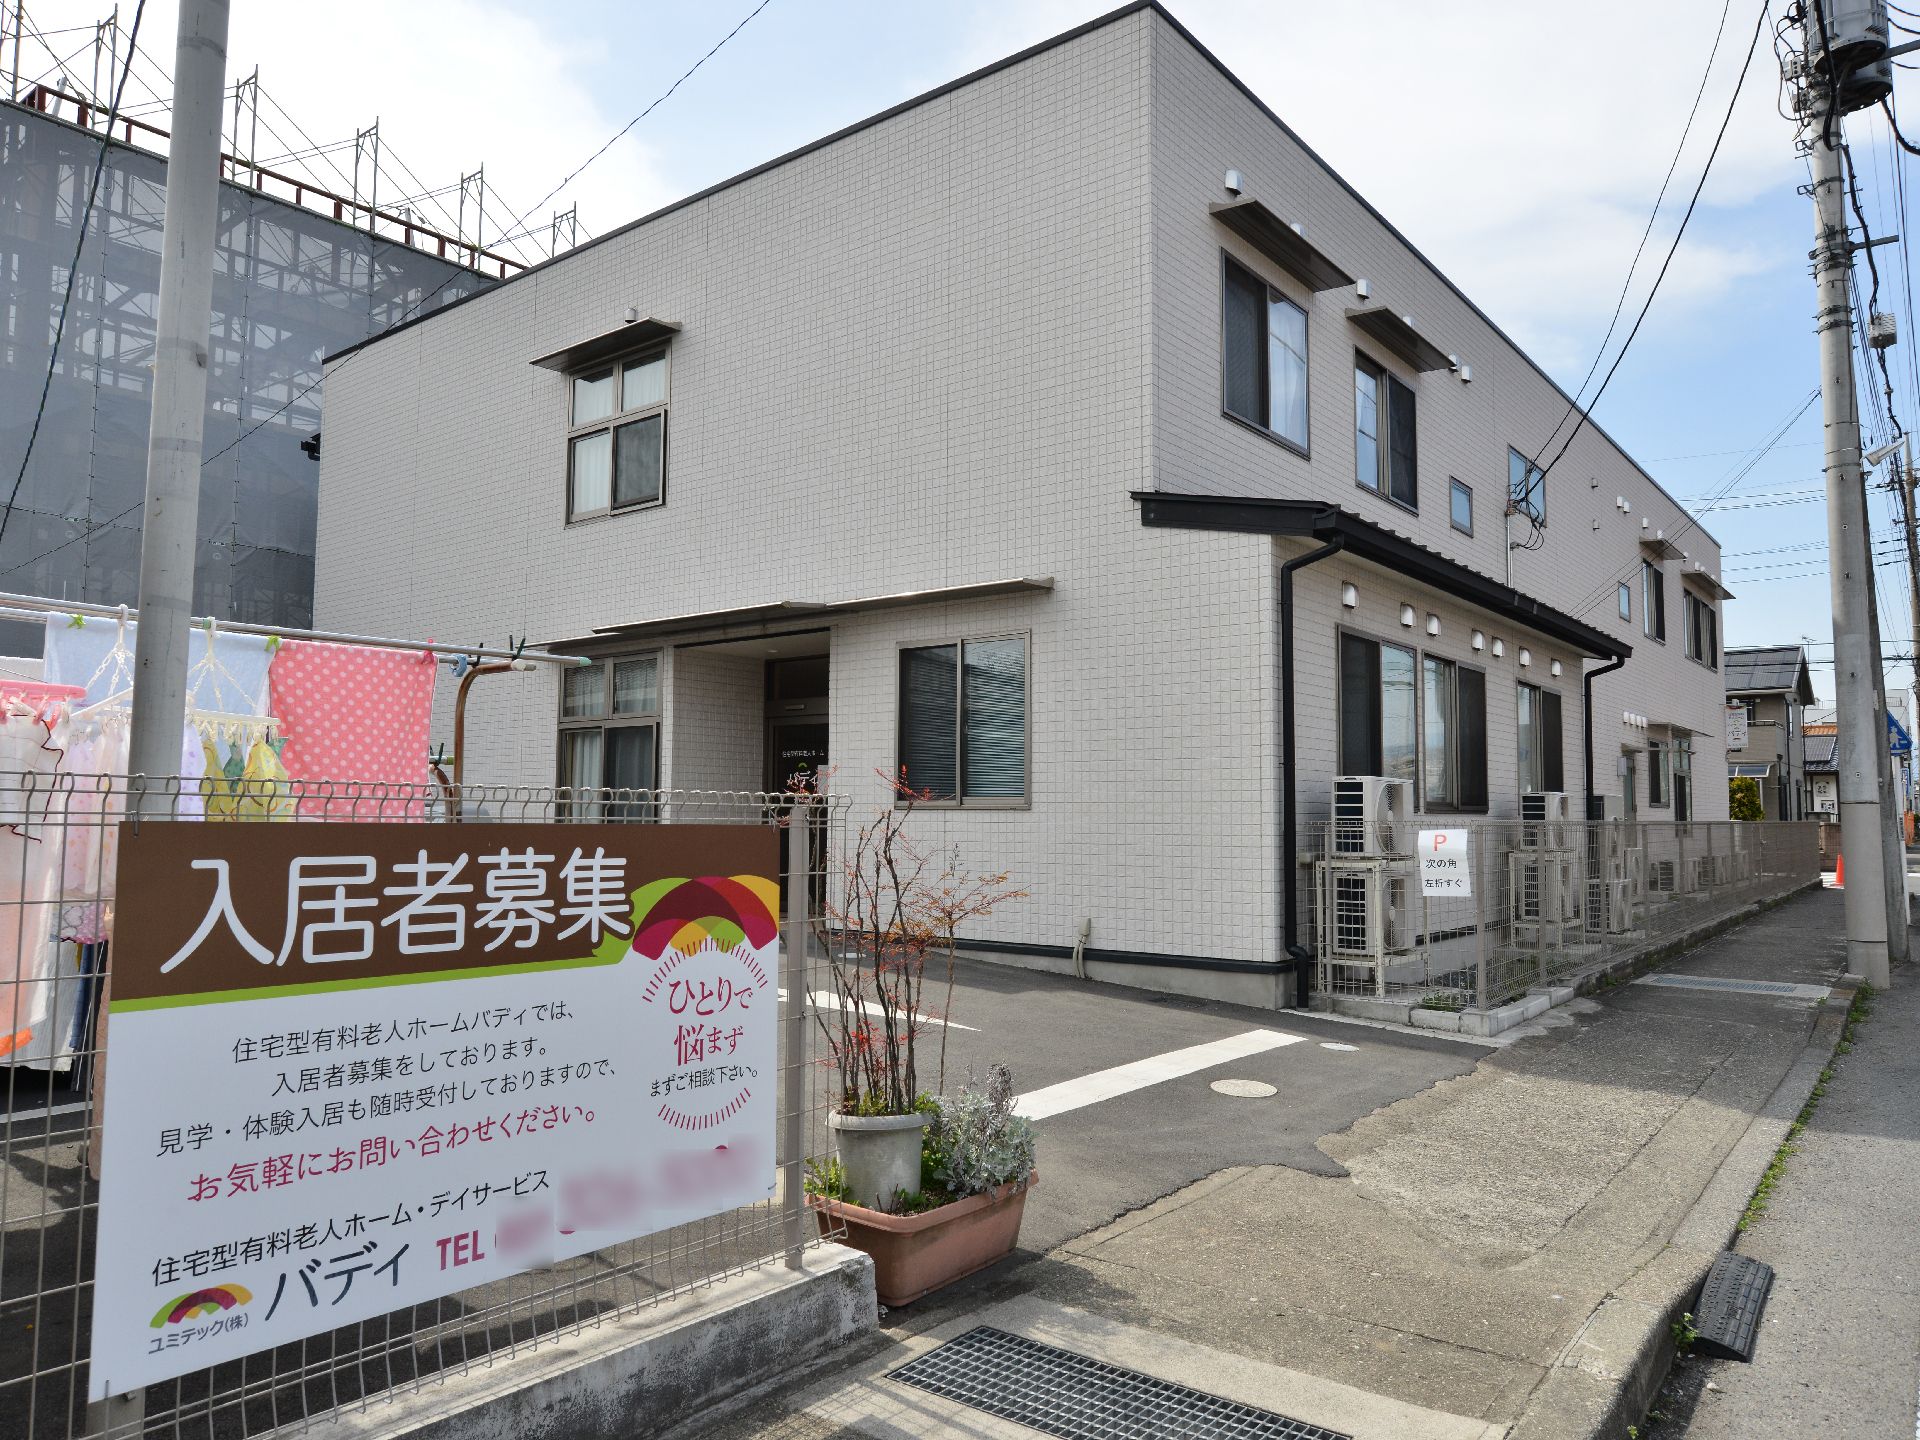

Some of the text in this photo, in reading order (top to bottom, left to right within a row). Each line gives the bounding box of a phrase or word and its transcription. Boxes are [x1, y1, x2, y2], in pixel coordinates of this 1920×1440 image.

[1425, 858, 1457, 869] 次の角
[1434, 834, 1447, 852] P
[1424, 878, 1463, 888] 左折すぐ
[160, 846, 631, 974] 入居者募集
[668, 976, 753, 1016] ひとりで
[232, 1000, 573, 1064] 住宅型有料老人ホームバディでは、
[673, 1023, 744, 1067] 悩まず
[271, 1036, 547, 1098] 入居者募集をしております。
[650, 1064, 758, 1098] まずご相談下さい。
[156, 1058, 615, 1158] 見学・体験入居も随時受付しておりますので、
[186, 1104, 595, 1202] お気軽にお問い合わせください。
[436, 1229, 485, 1272] TEL
[264, 1239, 410, 1322] バディ
[148, 1311, 248, 1356] ユミテック(株)
